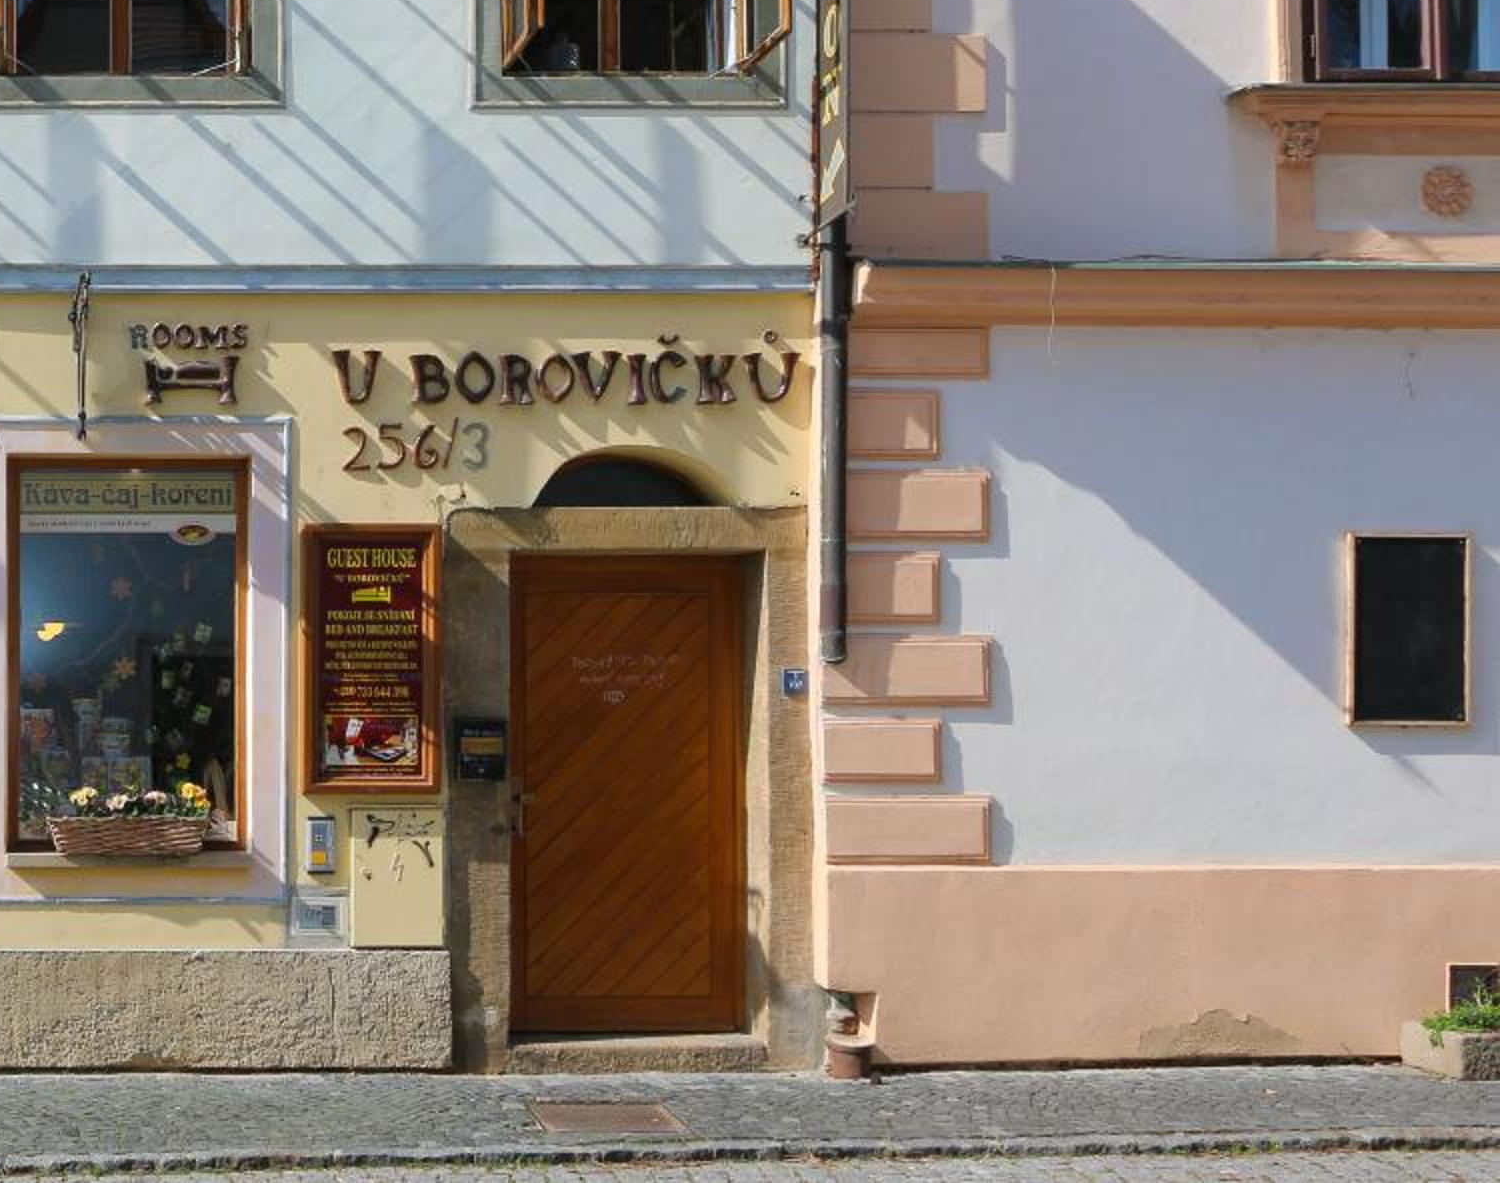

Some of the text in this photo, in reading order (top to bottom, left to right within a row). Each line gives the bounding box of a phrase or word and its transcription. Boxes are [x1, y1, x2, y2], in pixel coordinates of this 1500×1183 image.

[129, 322, 248, 350] ROOMS
[332, 329, 802, 406] U BOROVIČKŮ
[341, 419, 492, 472] 256/3
[327, 547, 417, 568] GUEST HOUSE
[345, 624, 364, 636] AND
